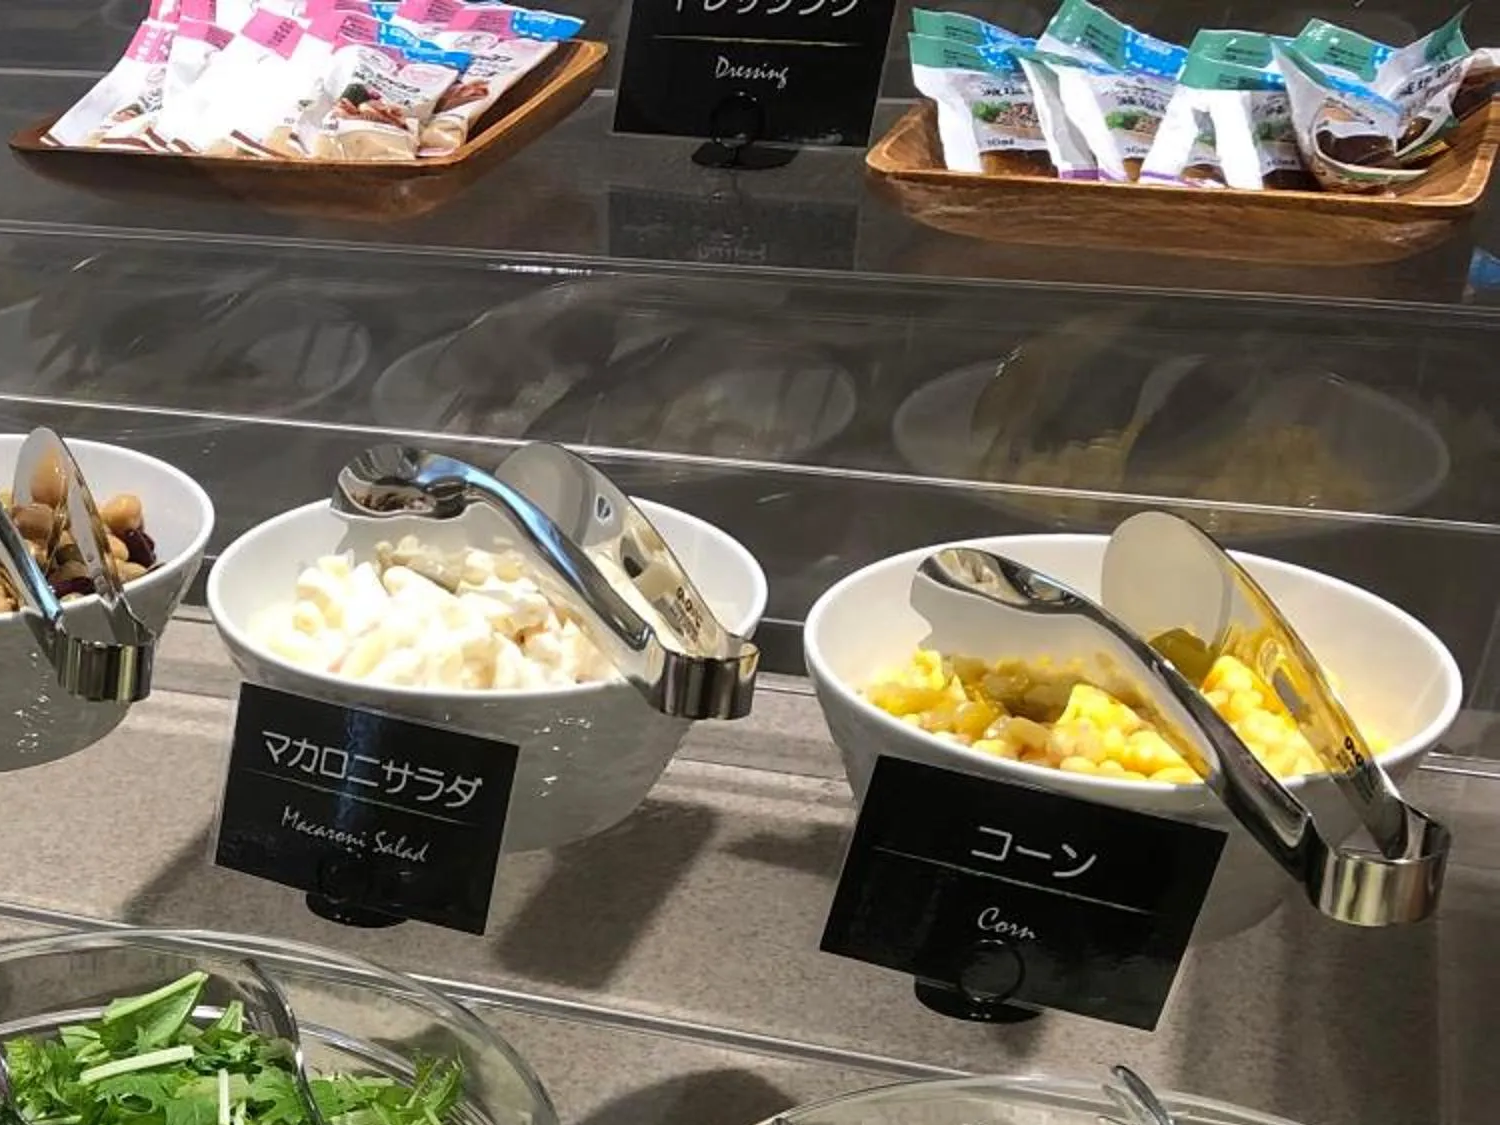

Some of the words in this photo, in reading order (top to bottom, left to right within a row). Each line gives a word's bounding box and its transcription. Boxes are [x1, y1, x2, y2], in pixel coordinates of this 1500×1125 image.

[715, 55, 789, 88] Dressing
[262, 730, 483, 807] マカロニサラダ
[281, 805, 366, 848] Macaroni
[372, 831, 430, 863] Salad
[970, 825, 1097, 878] コーン
[977, 907, 1041, 941] Corn
